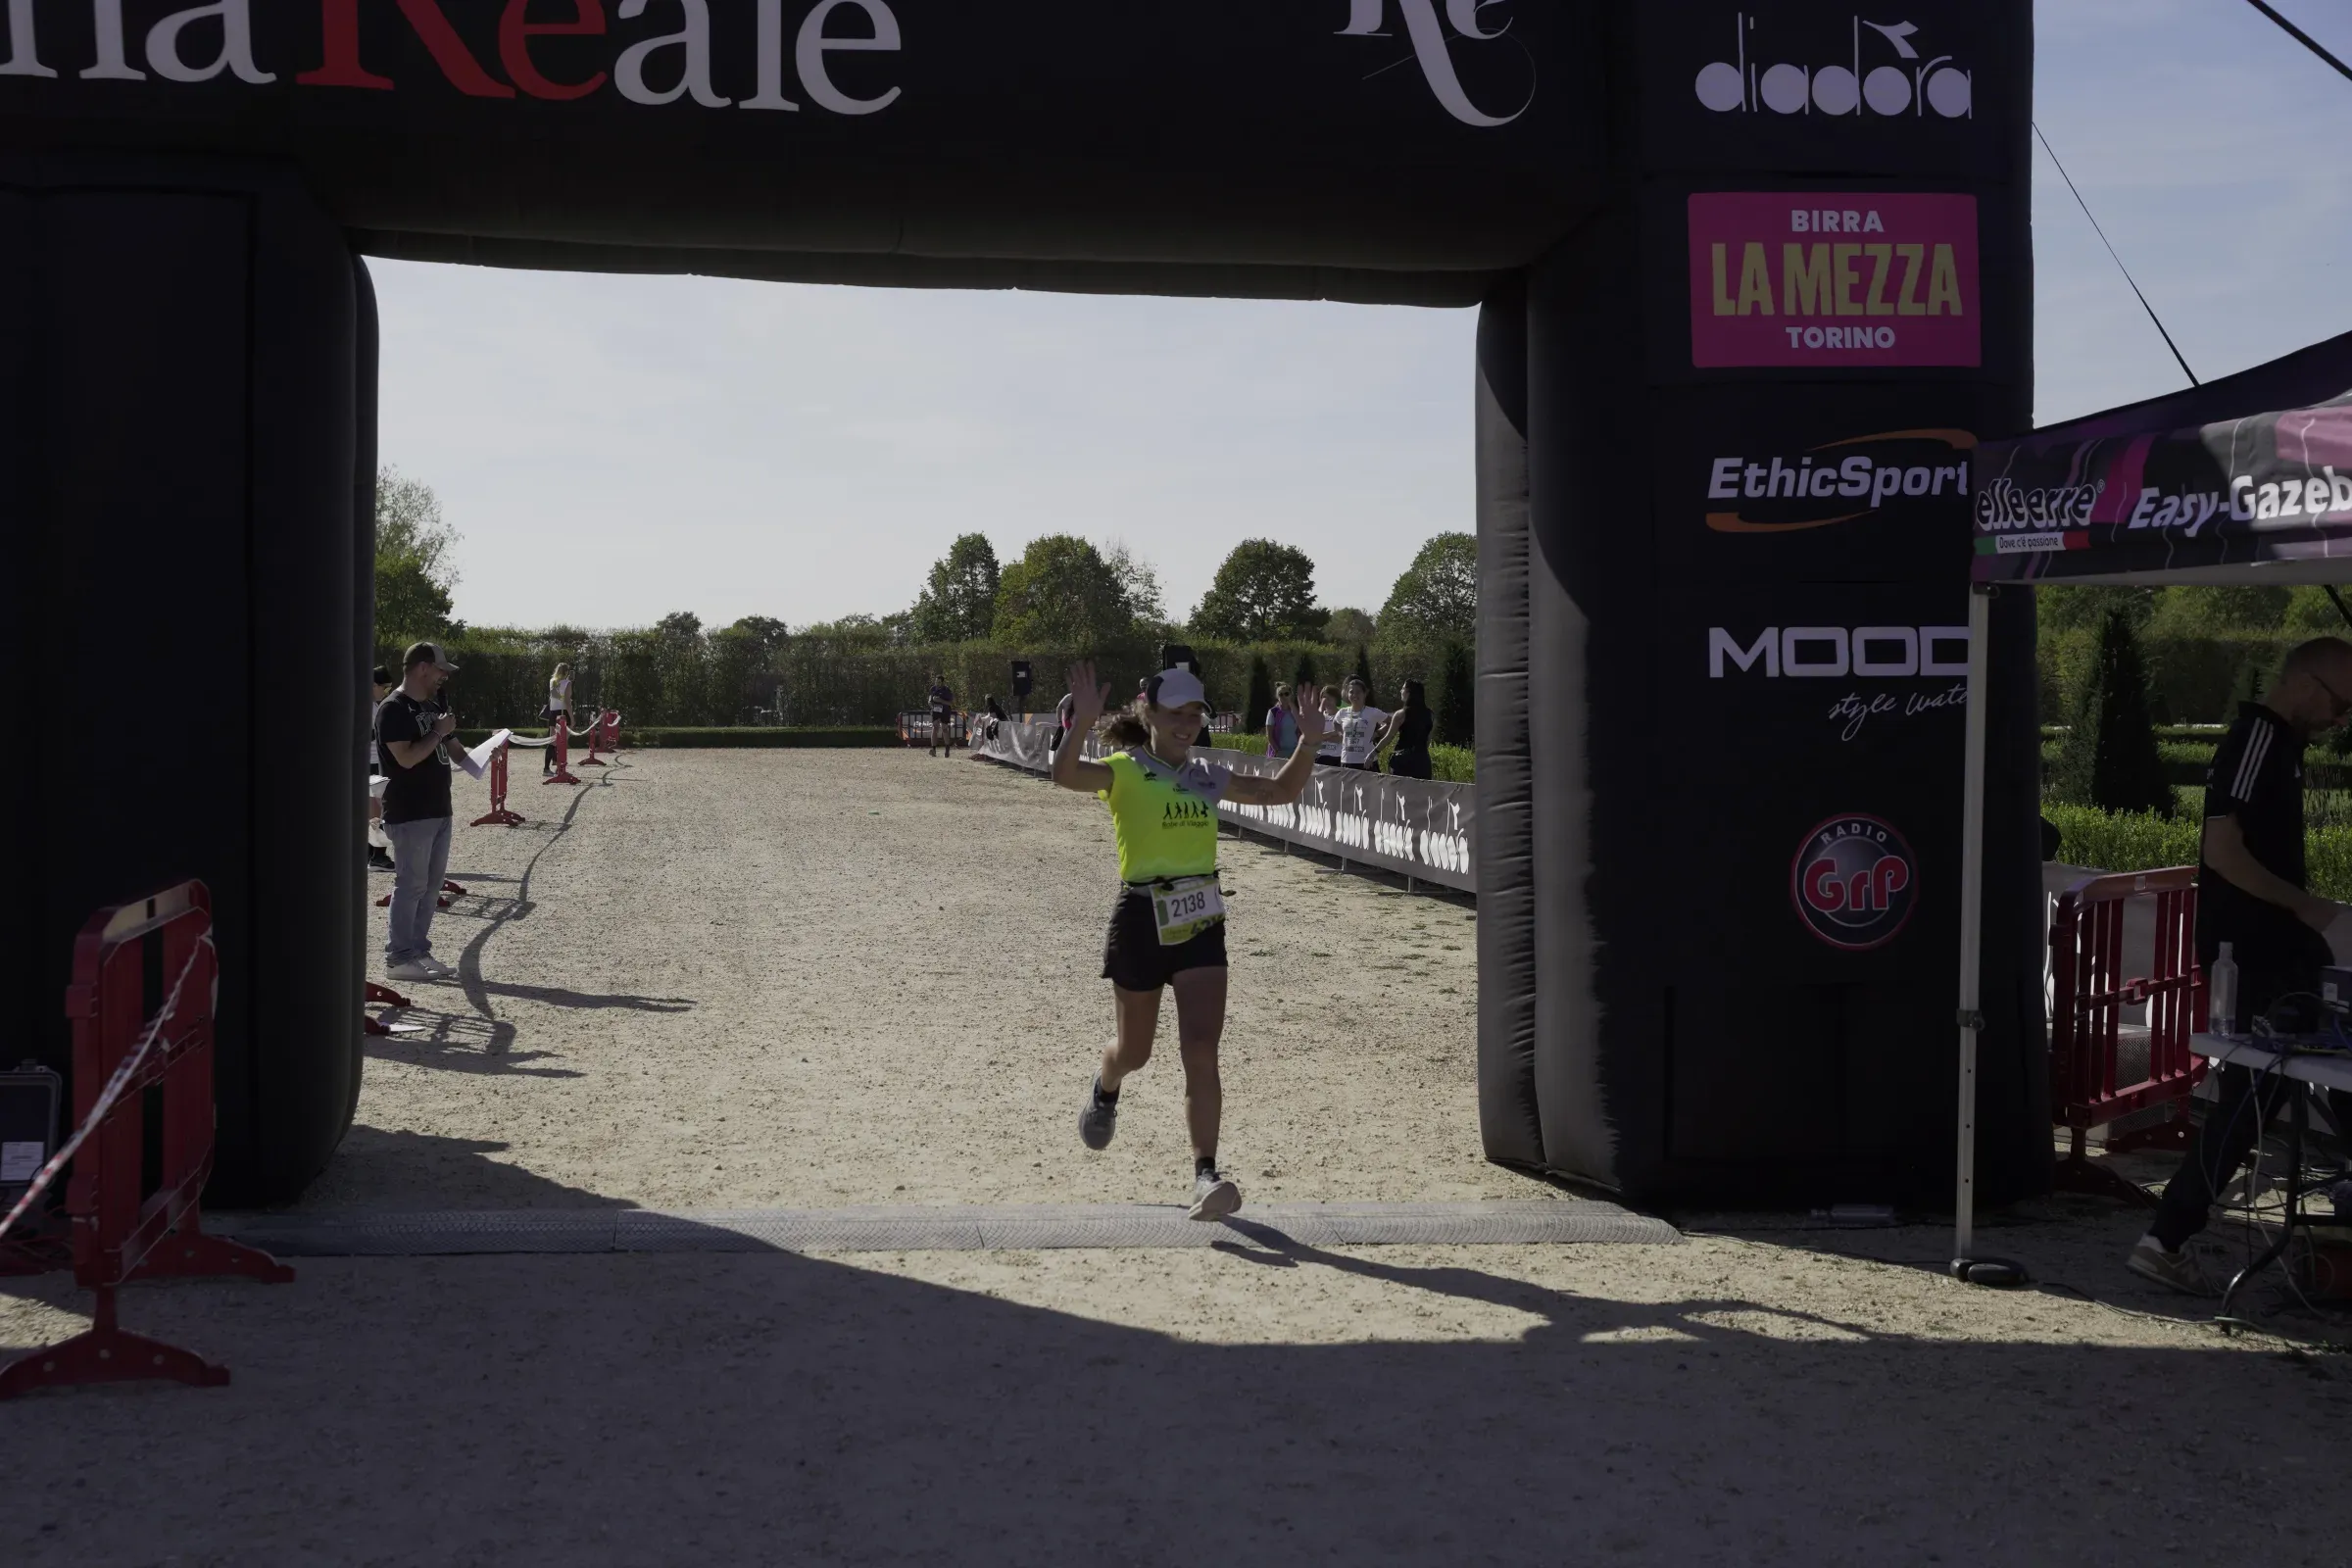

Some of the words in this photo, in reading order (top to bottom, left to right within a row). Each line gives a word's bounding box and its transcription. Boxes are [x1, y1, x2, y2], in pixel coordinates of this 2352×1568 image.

[1694, 12, 1972, 120] diadora
[1790, 209, 1885, 233] BIRRA
[1711, 242, 1776, 317] LA
[1782, 242, 1964, 317] MEZZA
[1785, 325, 1896, 349] TORINO
[2028, 535, 2059, 550] passione
[1827, 691, 1898, 742] style
[1820, 822, 1887, 845] RADIO
[1170, 891, 1205, 918] 2138
